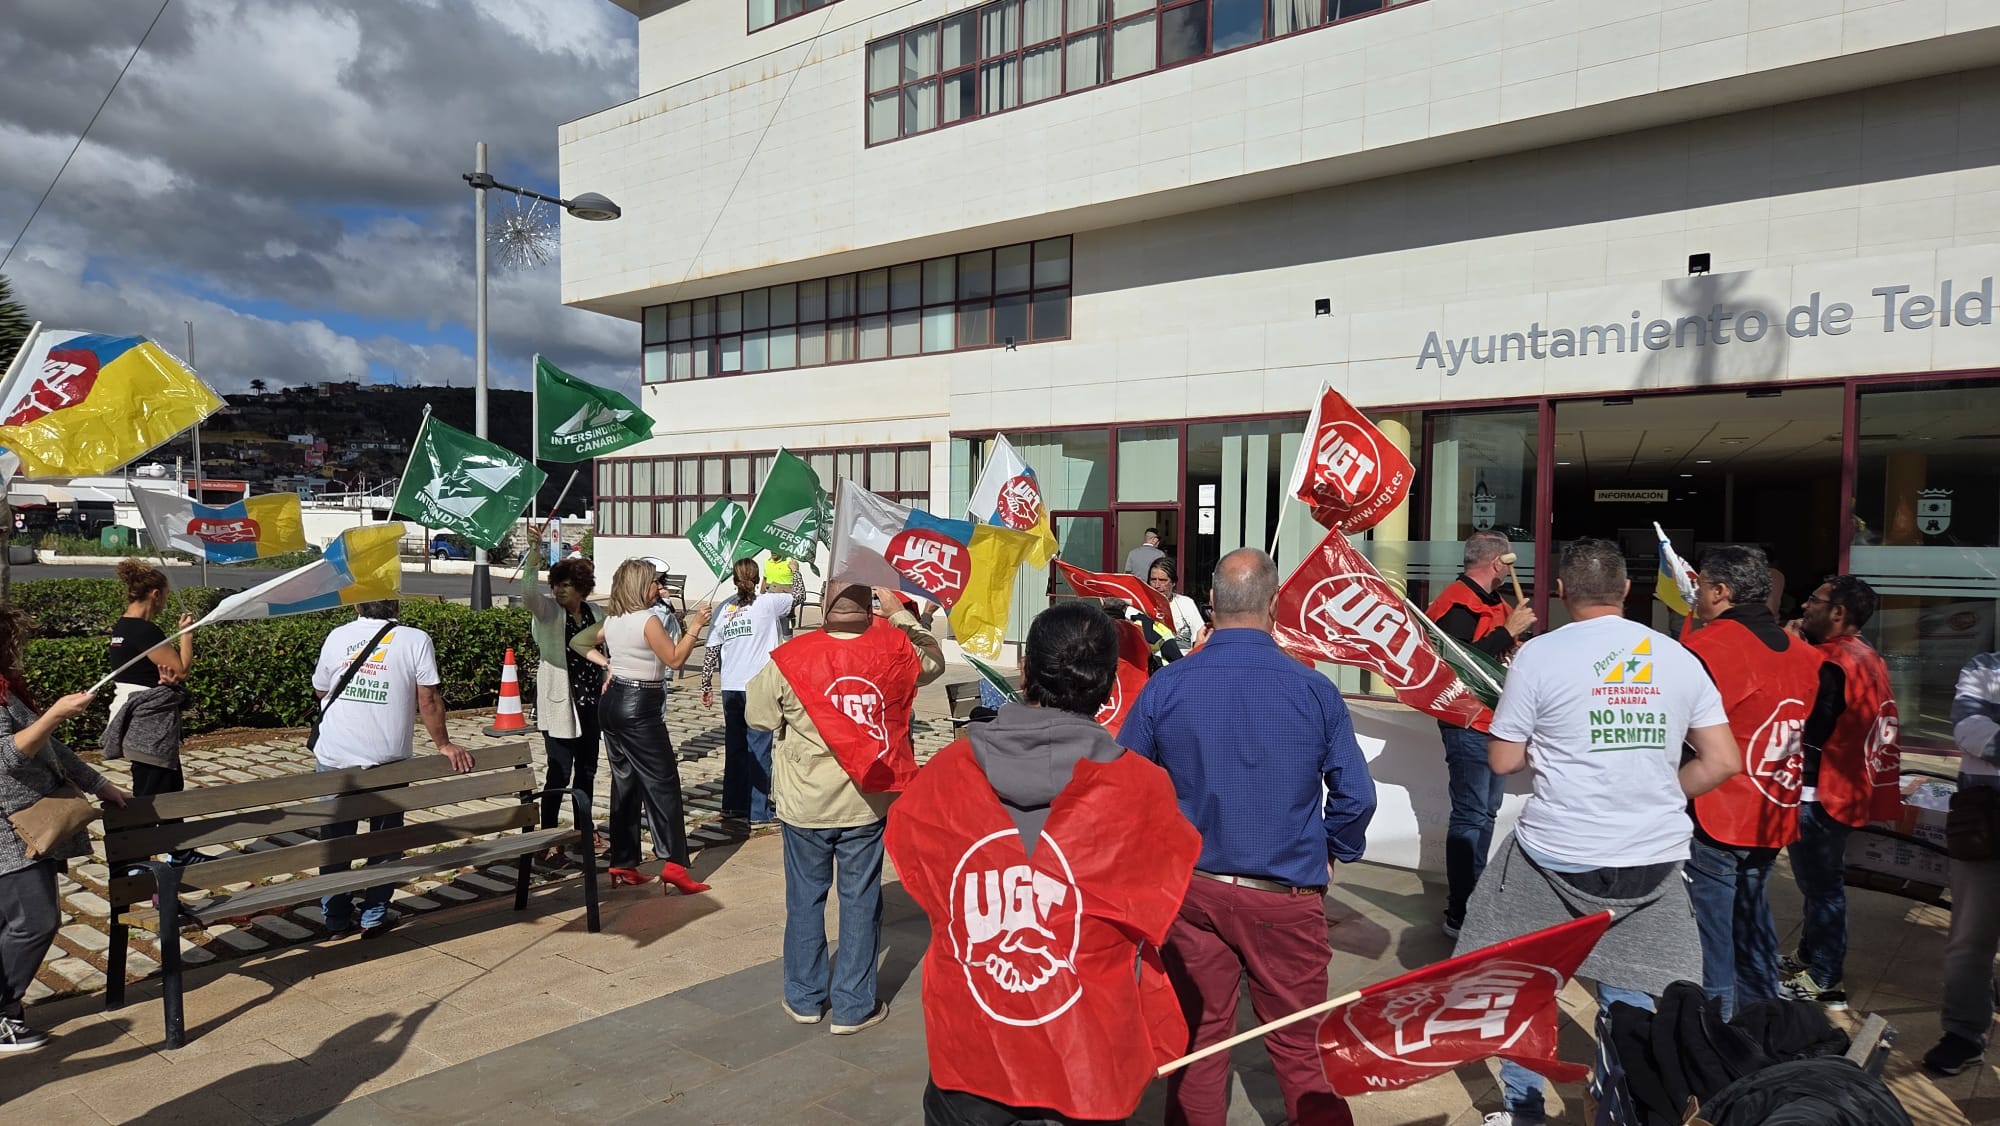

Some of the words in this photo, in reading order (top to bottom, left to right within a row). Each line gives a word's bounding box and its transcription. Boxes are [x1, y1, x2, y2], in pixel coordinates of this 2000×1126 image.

[1416, 304, 1769, 376] Ayuntamiento
[1785, 292, 1854, 337] de
[1872, 276, 1993, 333] Teld
[576, 434, 623, 454] CANARIA
[1318, 429, 1375, 495] UGT
[1598, 491, 1664, 499] INFORMACIÓN
[201, 521, 244, 536] UGT
[904, 535, 958, 569] UGT
[1325, 582, 1422, 668] UGT
[346, 639, 368, 656] Pero.
[368, 680, 380, 689] va
[383, 681, 389, 689] a
[1592, 687, 1661, 696] INTERSINDICAL
[345, 686, 388, 701] ERMITIR
[1608, 697, 1647, 705] CANARIA
[1590, 709, 1615, 726] NO
[1621, 709, 1633, 724] lo
[1637, 712, 1655, 724] va
[1660, 712, 1667, 725] a
[1591, 728, 1666, 744] PERMITIR
[963, 865, 1067, 944] UGT
